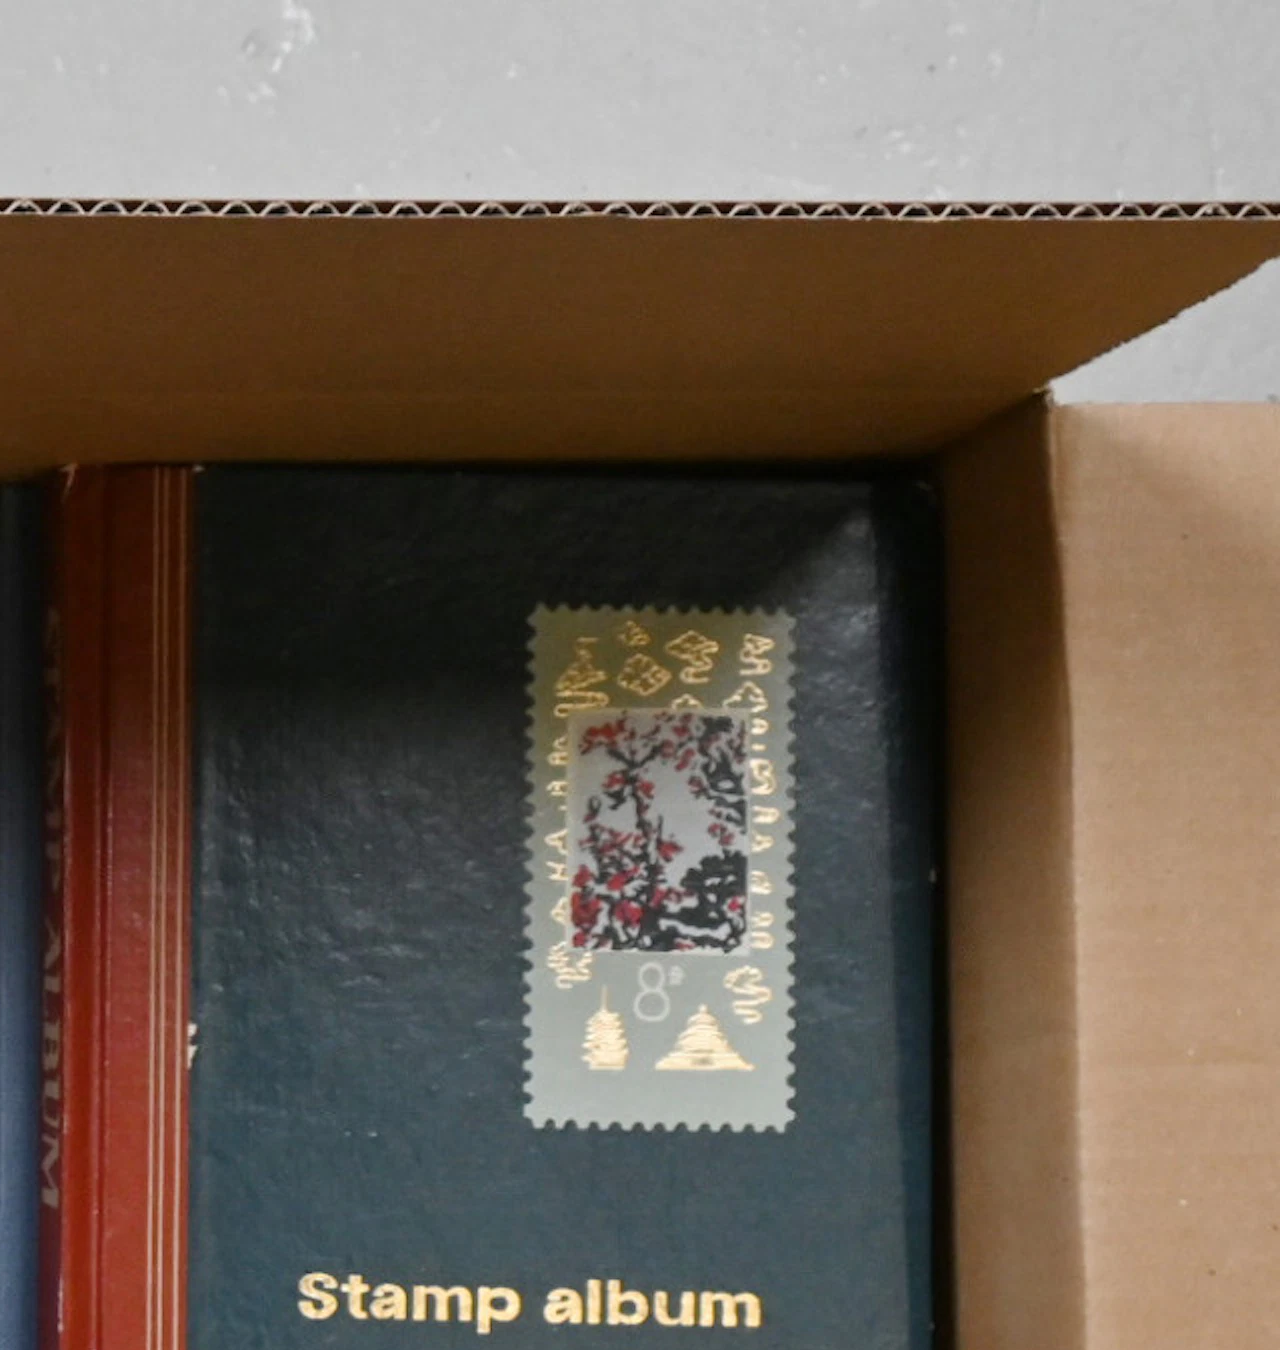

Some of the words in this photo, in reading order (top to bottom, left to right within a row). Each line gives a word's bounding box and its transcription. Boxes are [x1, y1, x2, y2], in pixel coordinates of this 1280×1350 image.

[43, 916, 61, 1209] ALBUM
[297, 1270, 523, 1335] Stamp
[542, 1278, 763, 1328] album
